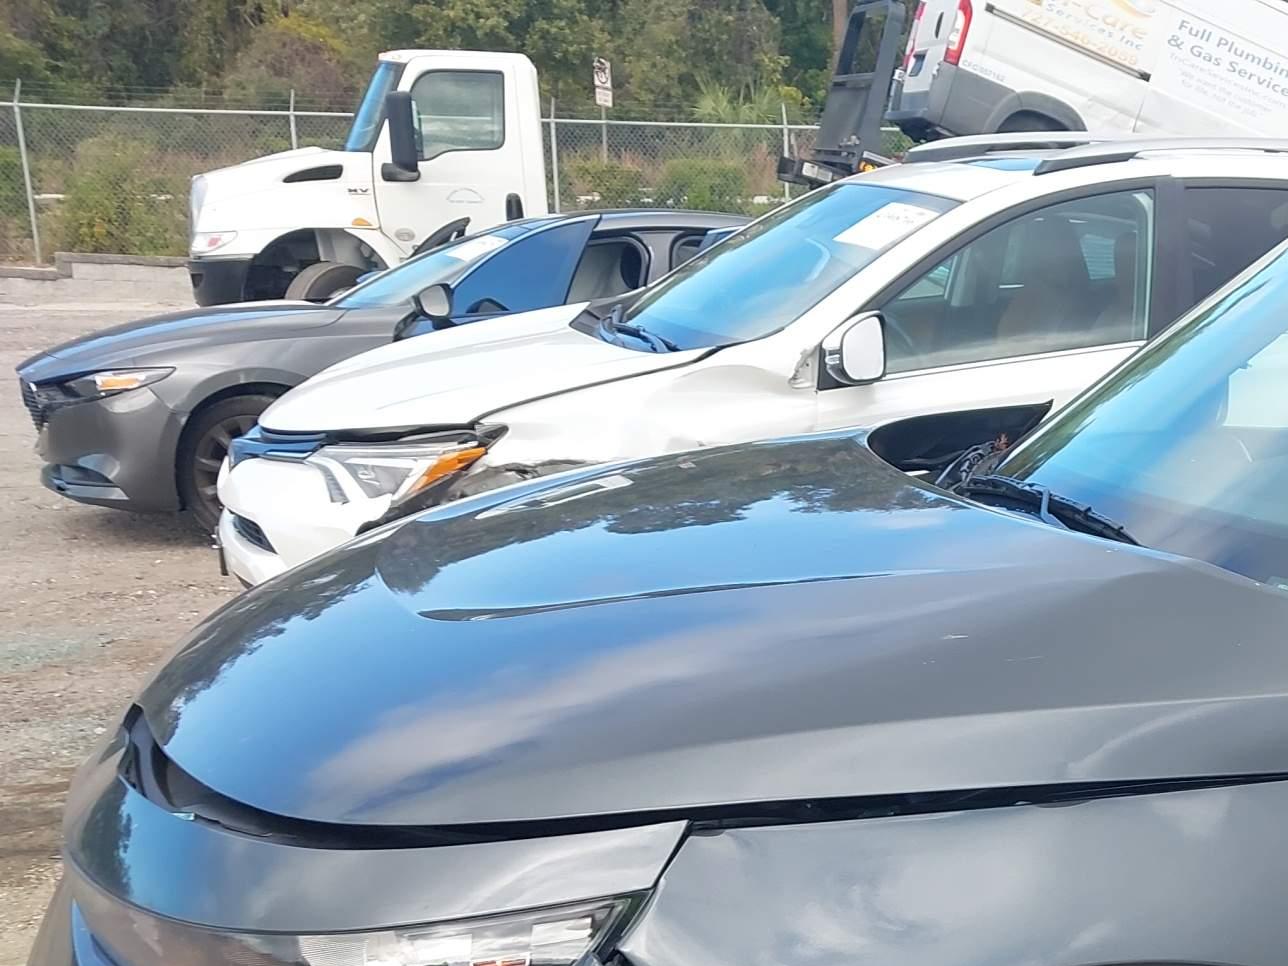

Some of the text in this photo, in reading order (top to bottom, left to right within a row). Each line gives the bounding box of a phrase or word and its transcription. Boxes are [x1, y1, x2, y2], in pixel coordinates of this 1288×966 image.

[1046, 3, 1143, 50] Services Inc
[1178, 19, 1212, 42] Full
[1167, 34, 1184, 50] &
[1190, 44, 1222, 66] Gas
